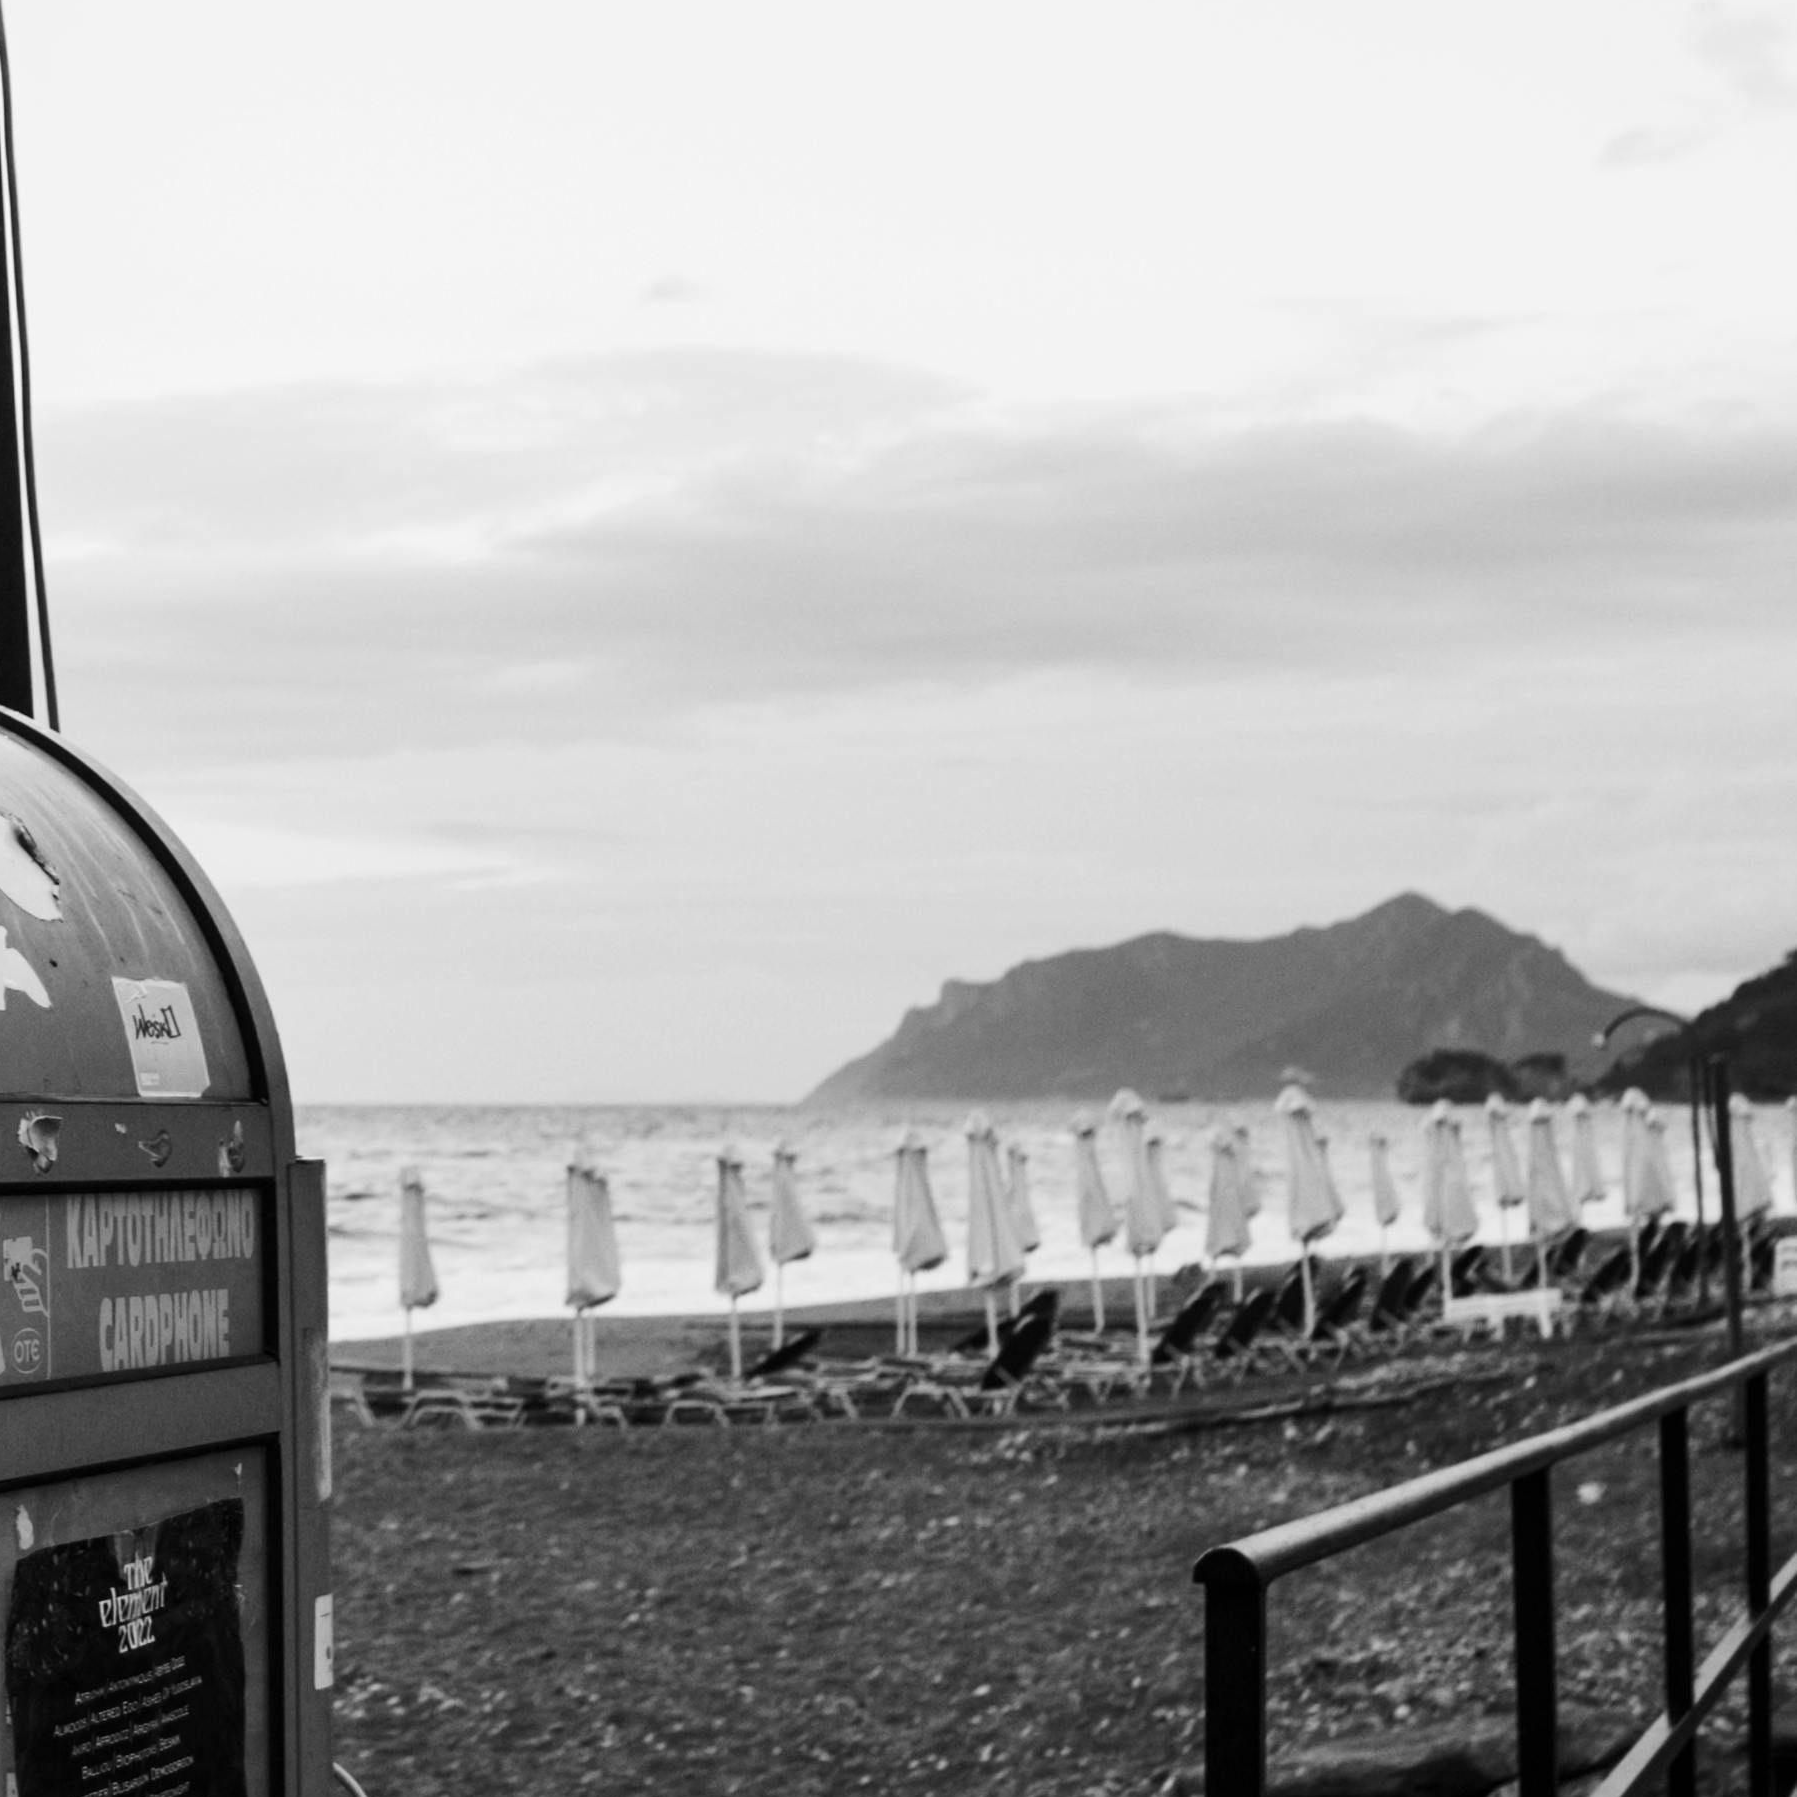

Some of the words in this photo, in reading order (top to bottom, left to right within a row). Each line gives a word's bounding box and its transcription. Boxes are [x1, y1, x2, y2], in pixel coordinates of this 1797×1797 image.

[100, 1288, 231, 1373] CARDPHONE
[99, 1571, 168, 1628] element
[119, 1616, 155, 1653] 2022
